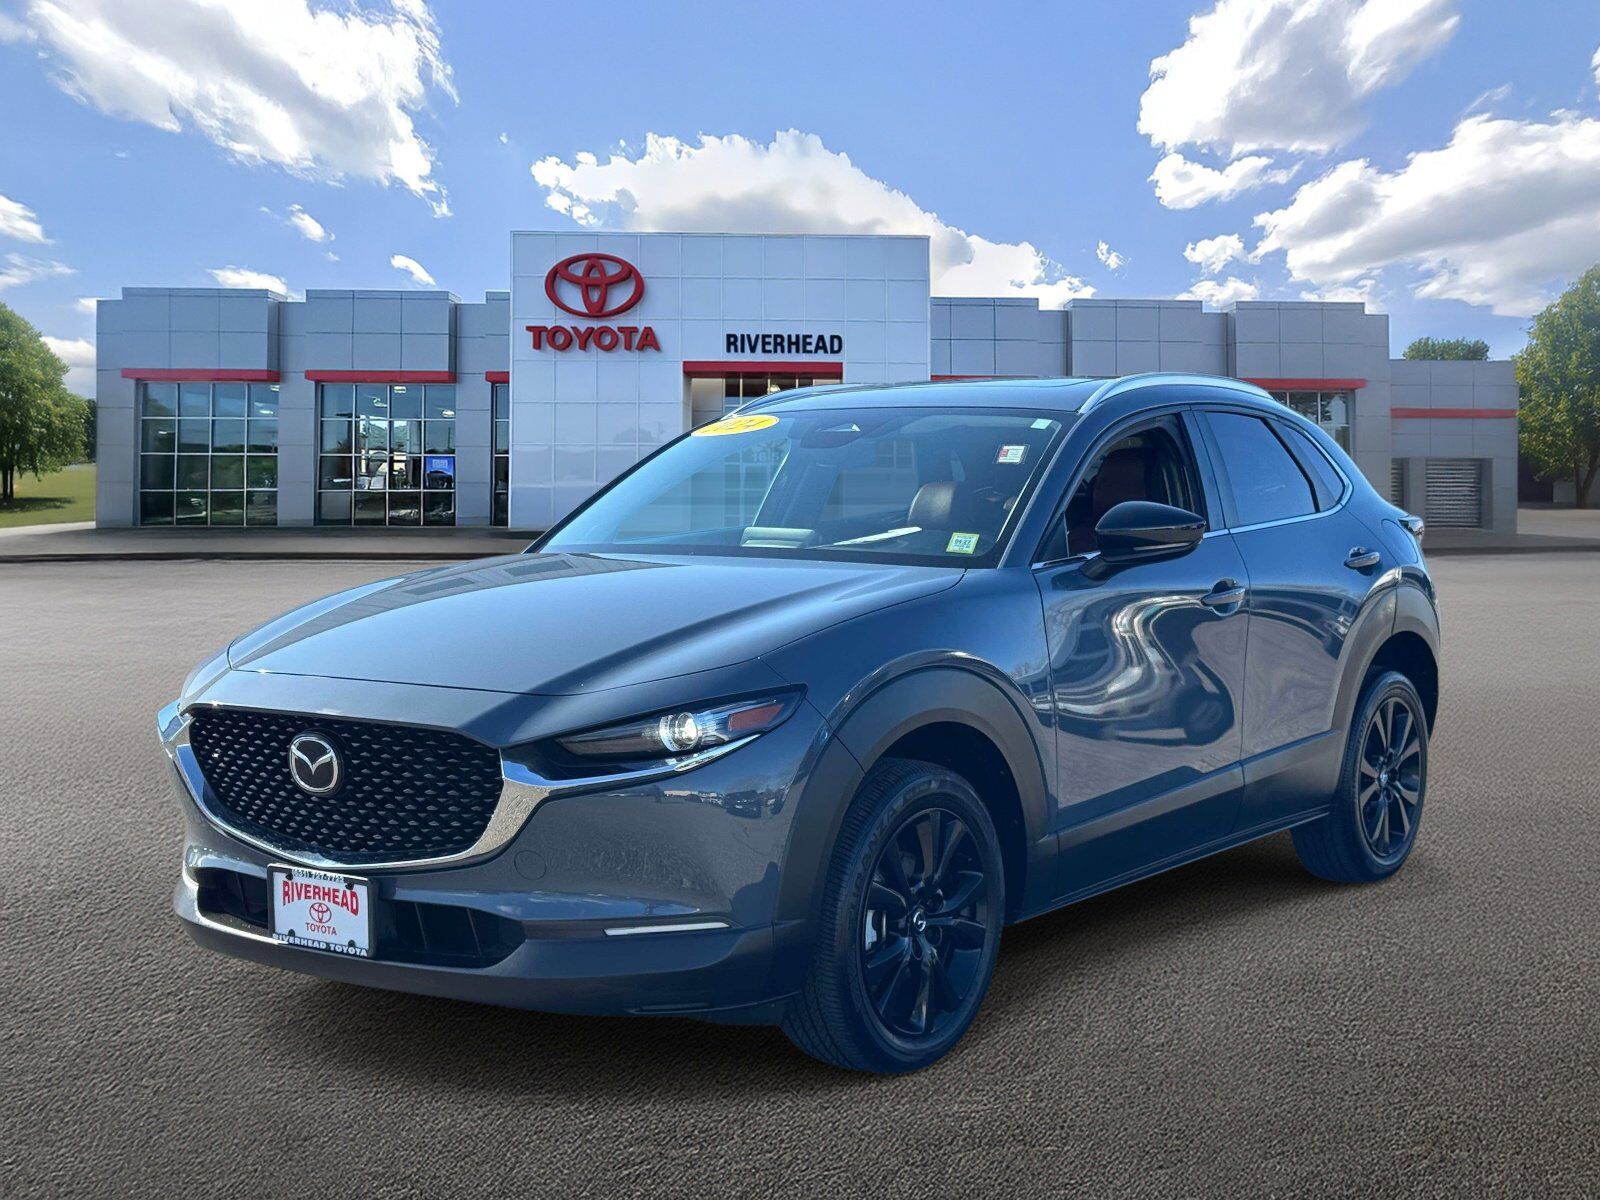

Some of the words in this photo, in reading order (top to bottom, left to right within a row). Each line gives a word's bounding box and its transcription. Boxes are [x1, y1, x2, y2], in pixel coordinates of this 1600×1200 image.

[526, 325, 661, 352] TOYOTA
[726, 333, 843, 355] RIVERHEAD
[282, 879, 359, 916] RIVERHEAD
[305, 922, 338, 936] TOYOTA
[272, 933, 327, 949] RIVERHEAD
[329, 943, 368, 957] TOYOTA
